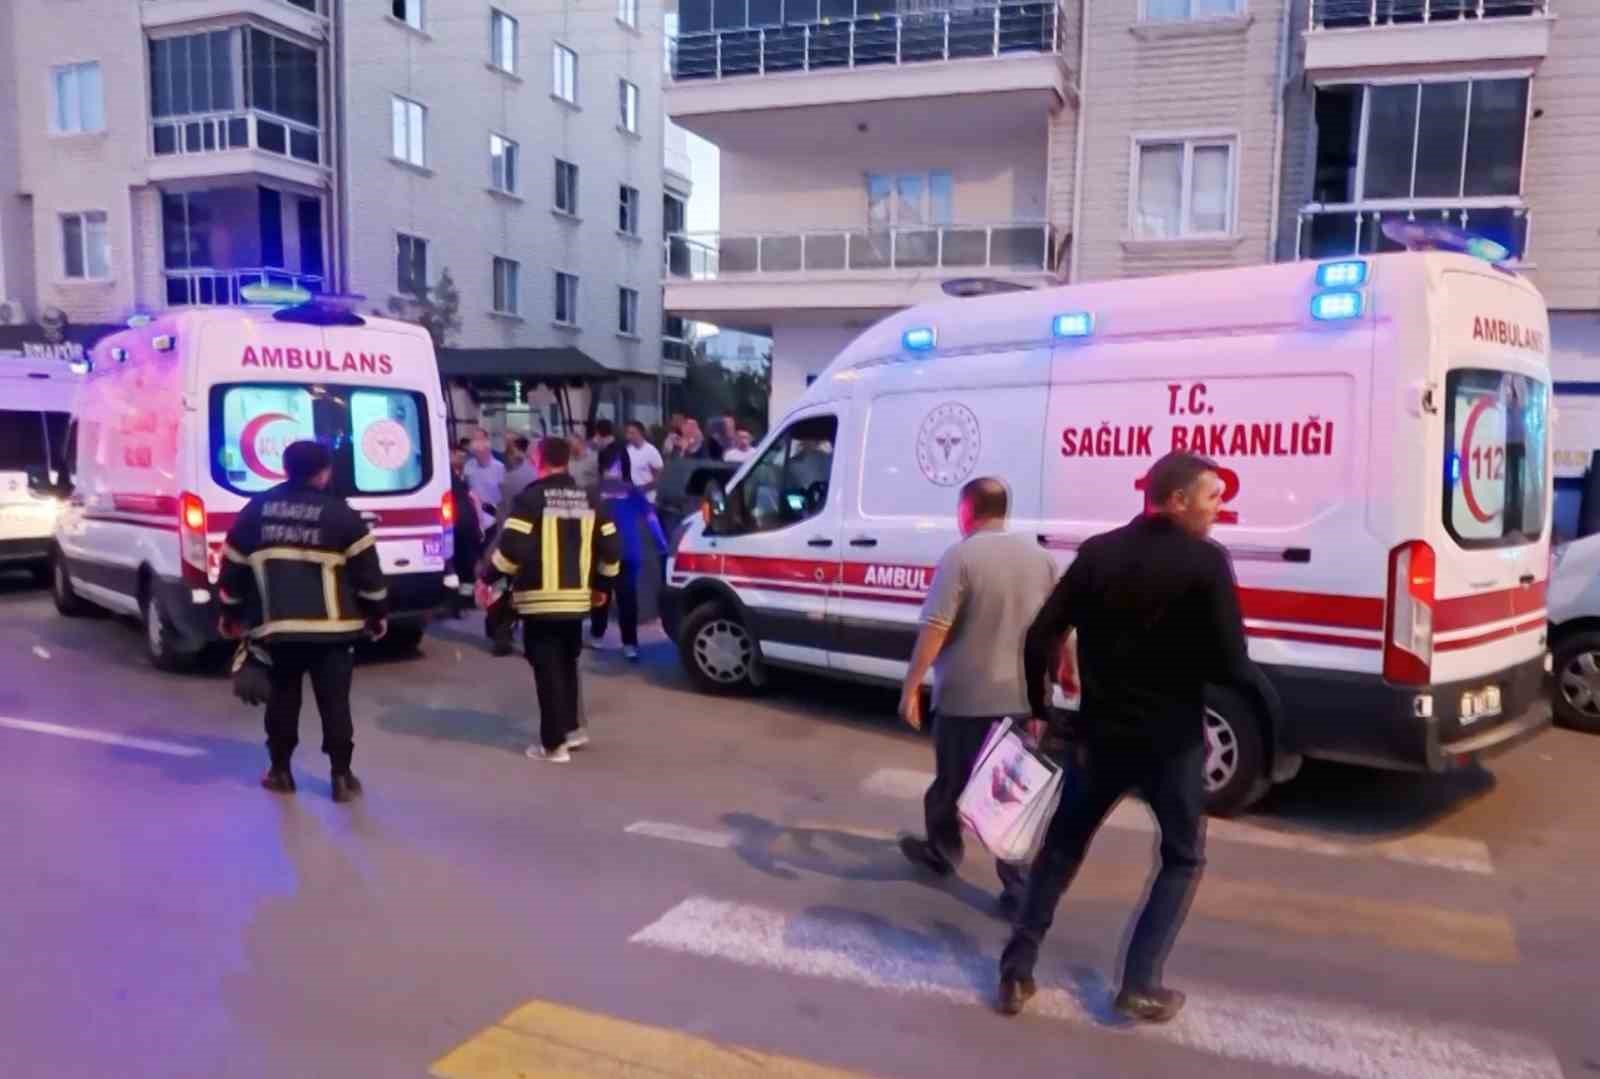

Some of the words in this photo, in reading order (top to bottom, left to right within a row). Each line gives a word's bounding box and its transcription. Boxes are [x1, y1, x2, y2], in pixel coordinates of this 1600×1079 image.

[241, 345, 394, 375] AMBULANS
[1167, 383, 1214, 415] T.C.
[1061, 420, 1153, 457] SAĞLIK
[1171, 415, 1334, 456] BAKANLIĞI
[1471, 445, 1505, 481] 112
[863, 565, 931, 590] AMBUL
